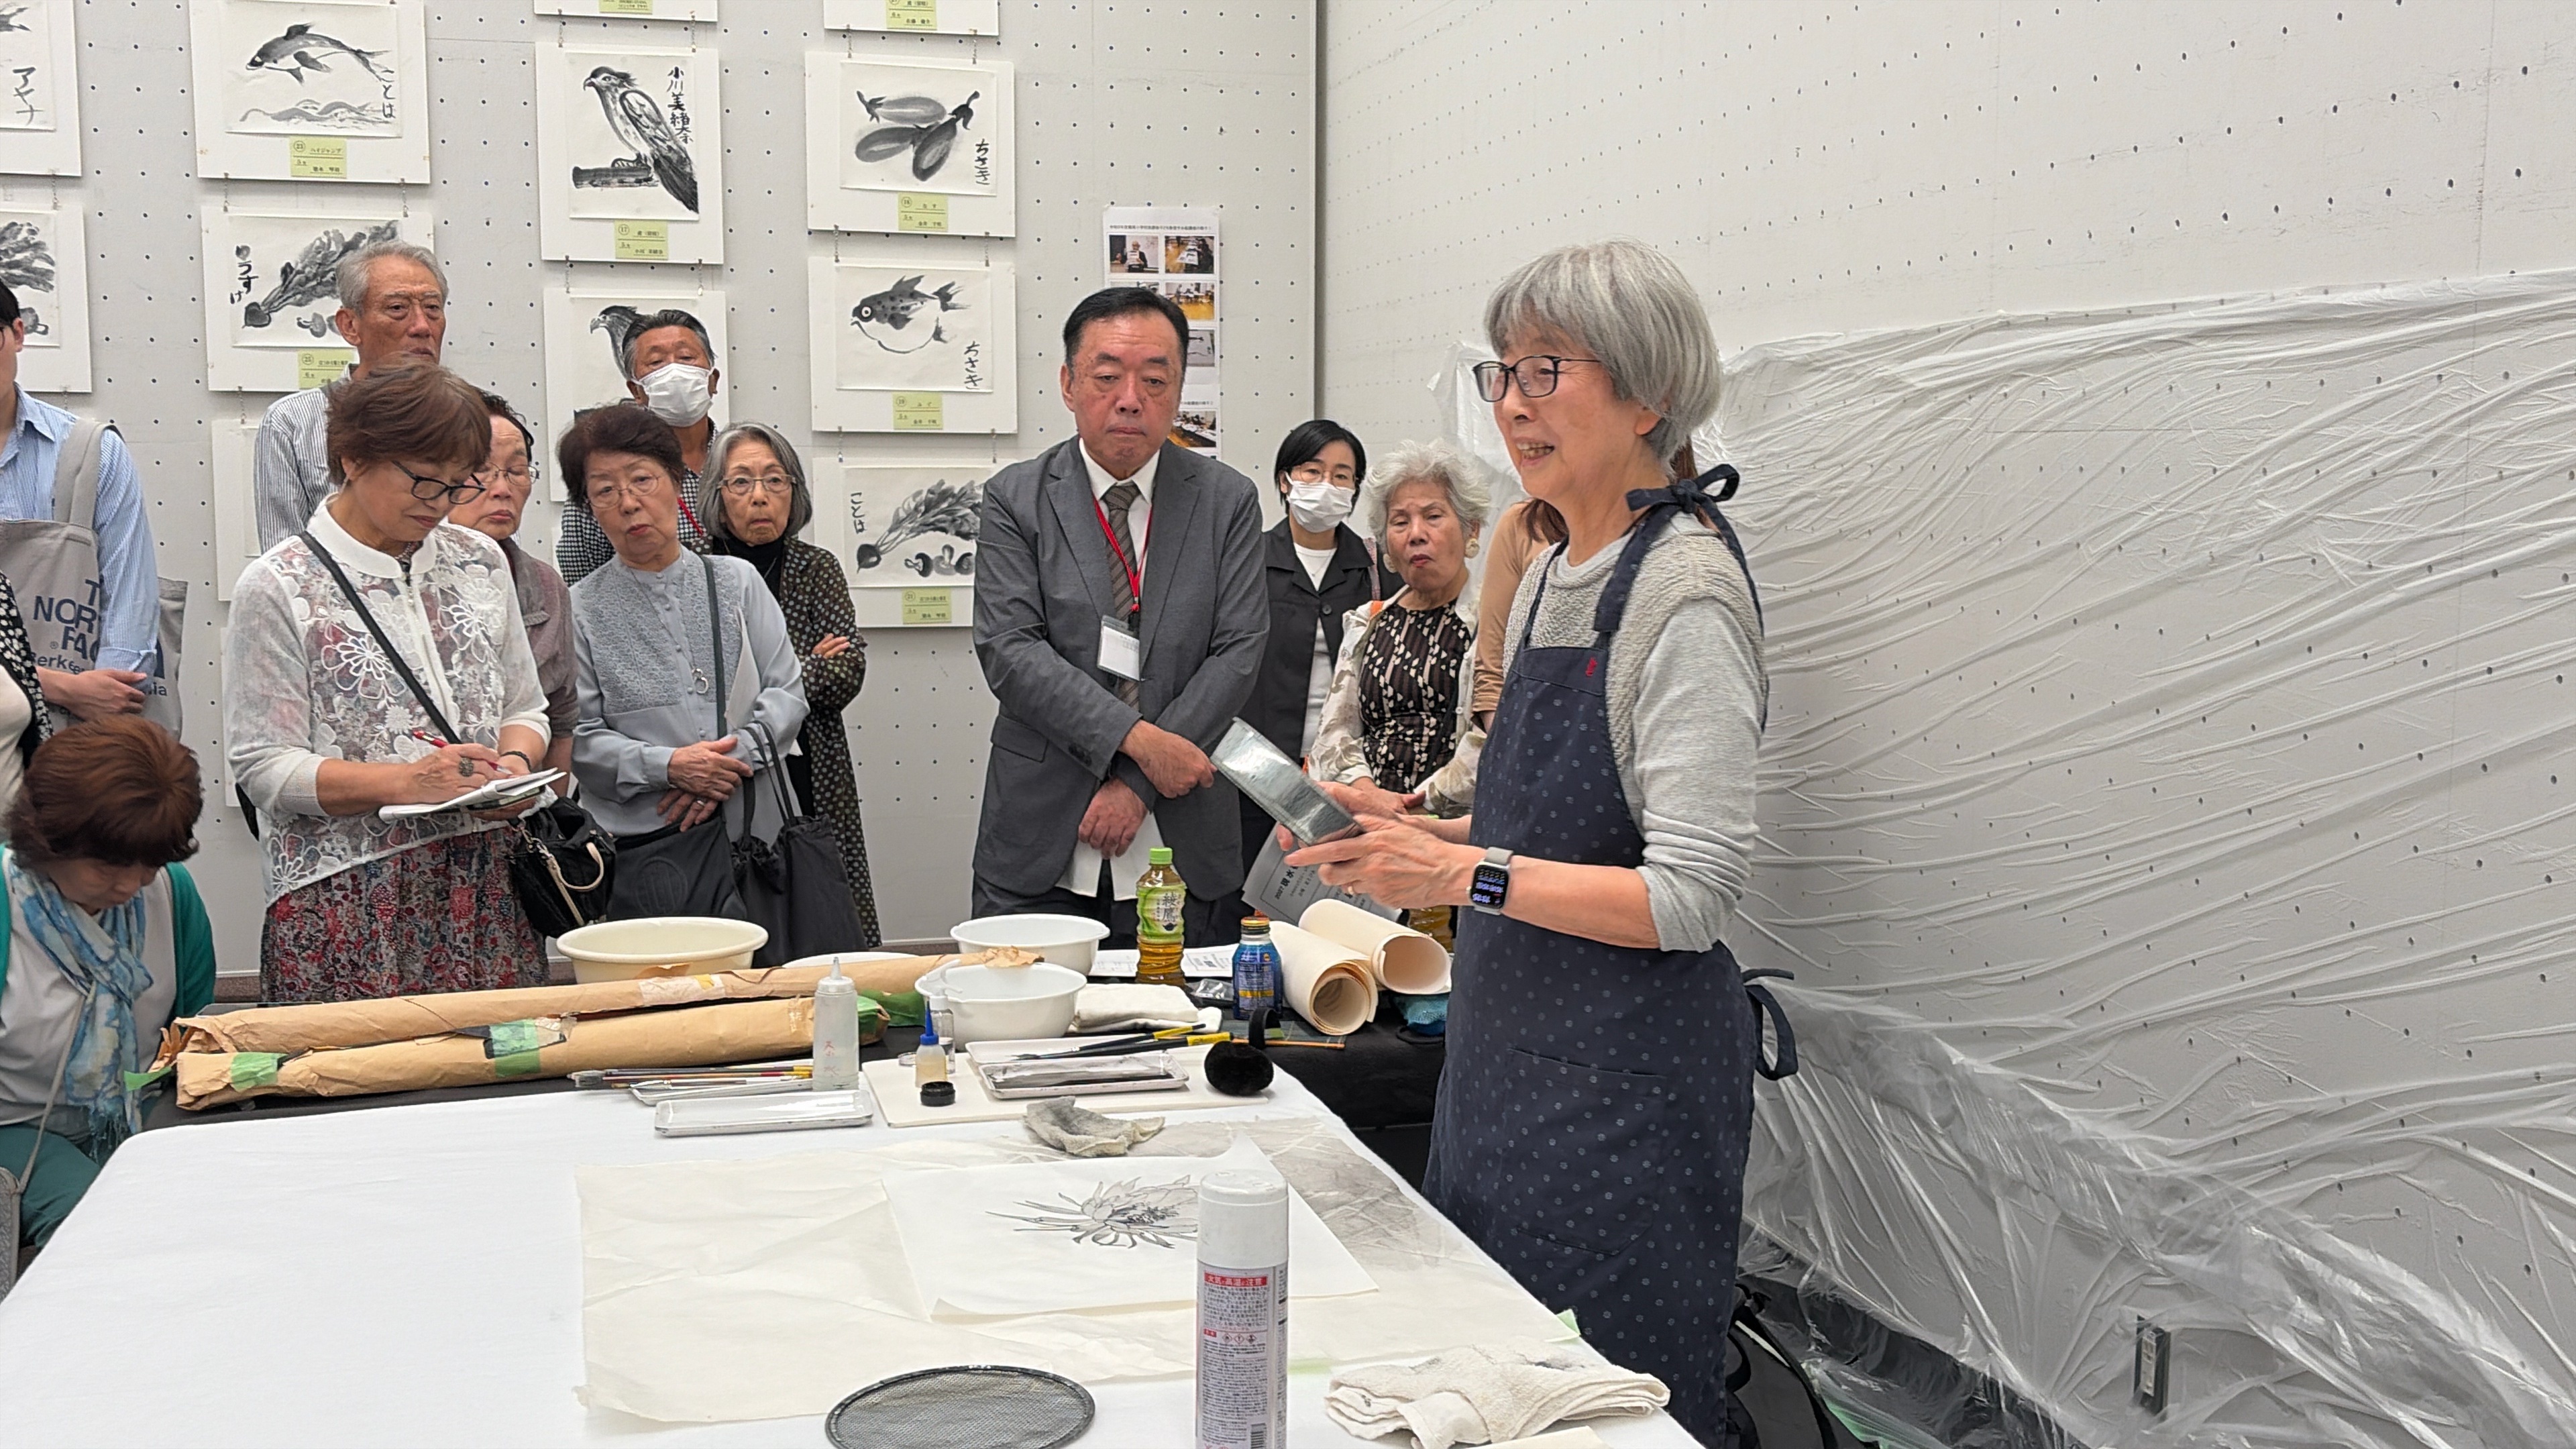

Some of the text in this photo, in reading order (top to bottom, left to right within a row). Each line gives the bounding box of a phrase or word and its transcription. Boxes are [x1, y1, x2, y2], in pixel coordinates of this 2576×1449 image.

[381, 70, 396, 119] ことは
[975, 138, 990, 185] ちさき
[851, 492, 867, 535] ことは
